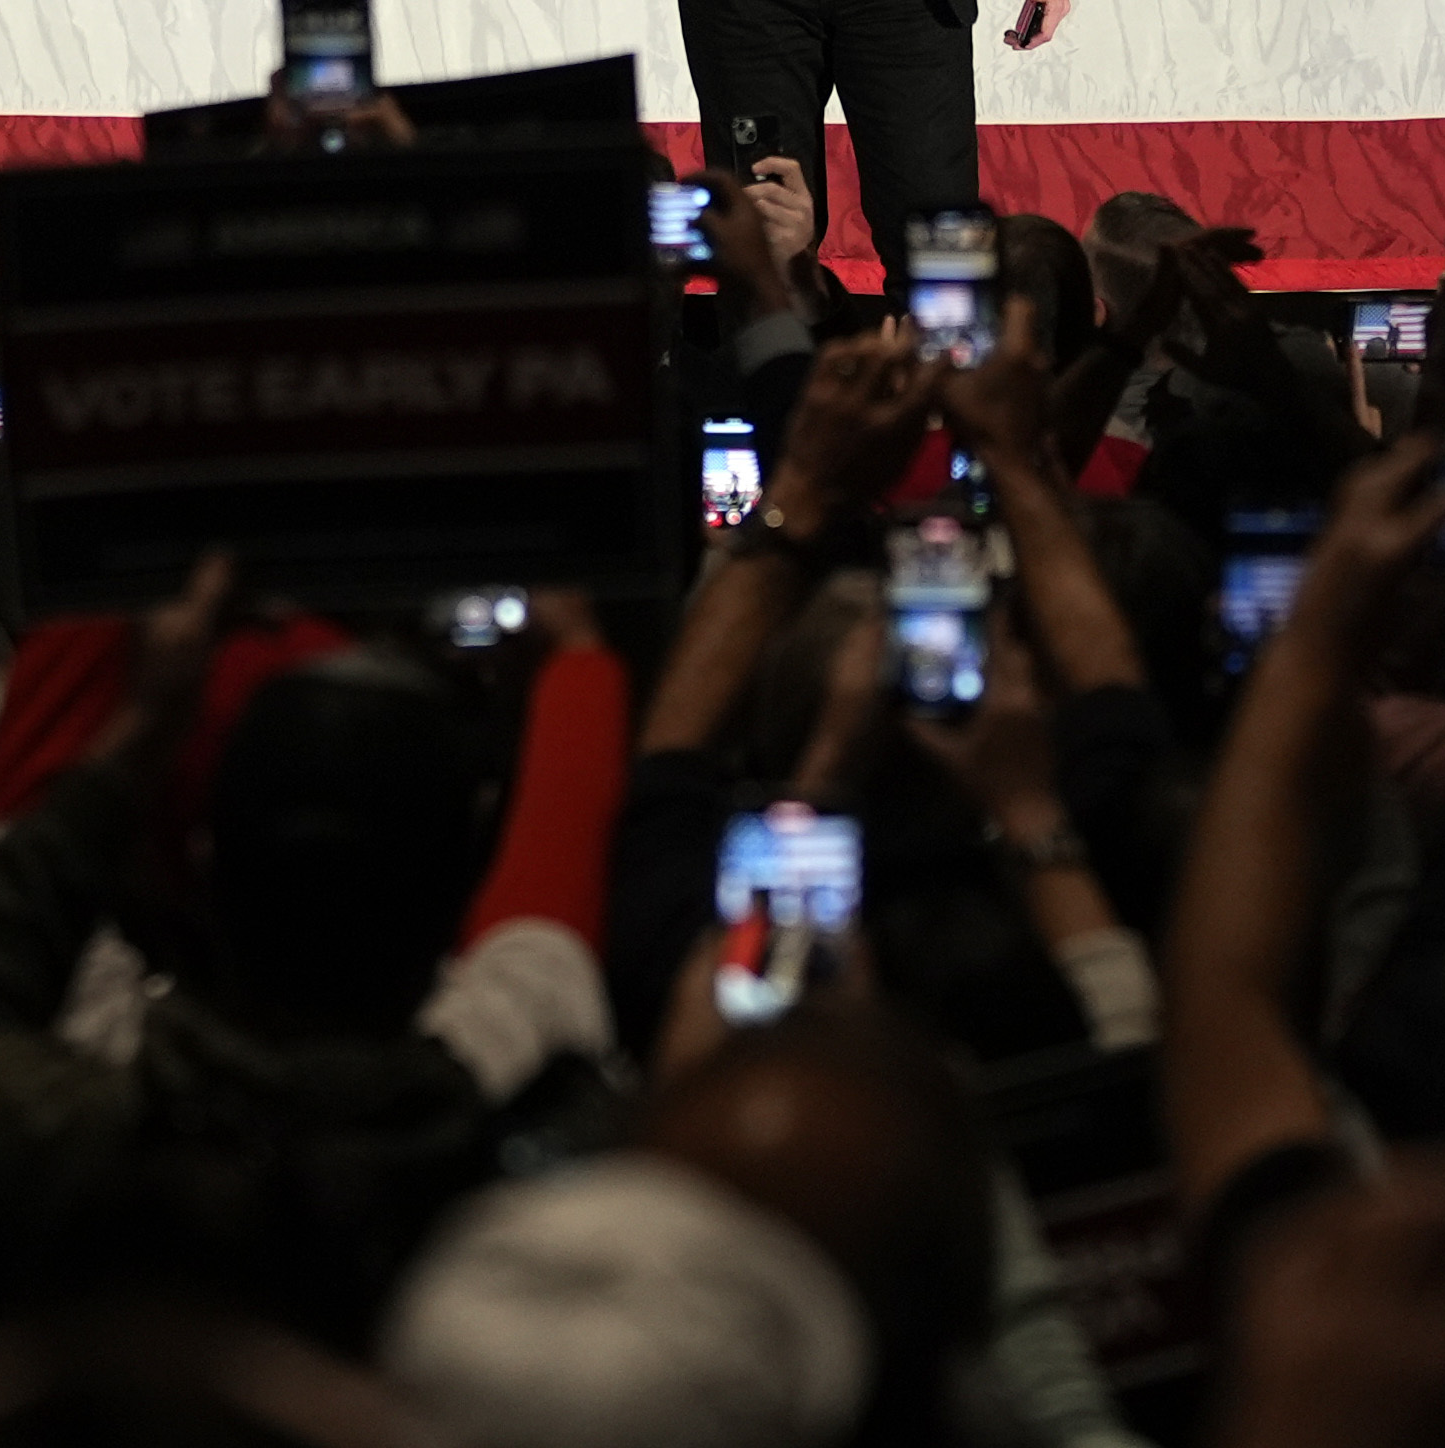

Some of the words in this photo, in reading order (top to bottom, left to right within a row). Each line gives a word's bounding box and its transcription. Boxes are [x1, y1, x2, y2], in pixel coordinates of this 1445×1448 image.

[42, 360, 241, 432] VOTE
[254, 350, 496, 419] EARLY
[506, 342, 615, 408] PA
